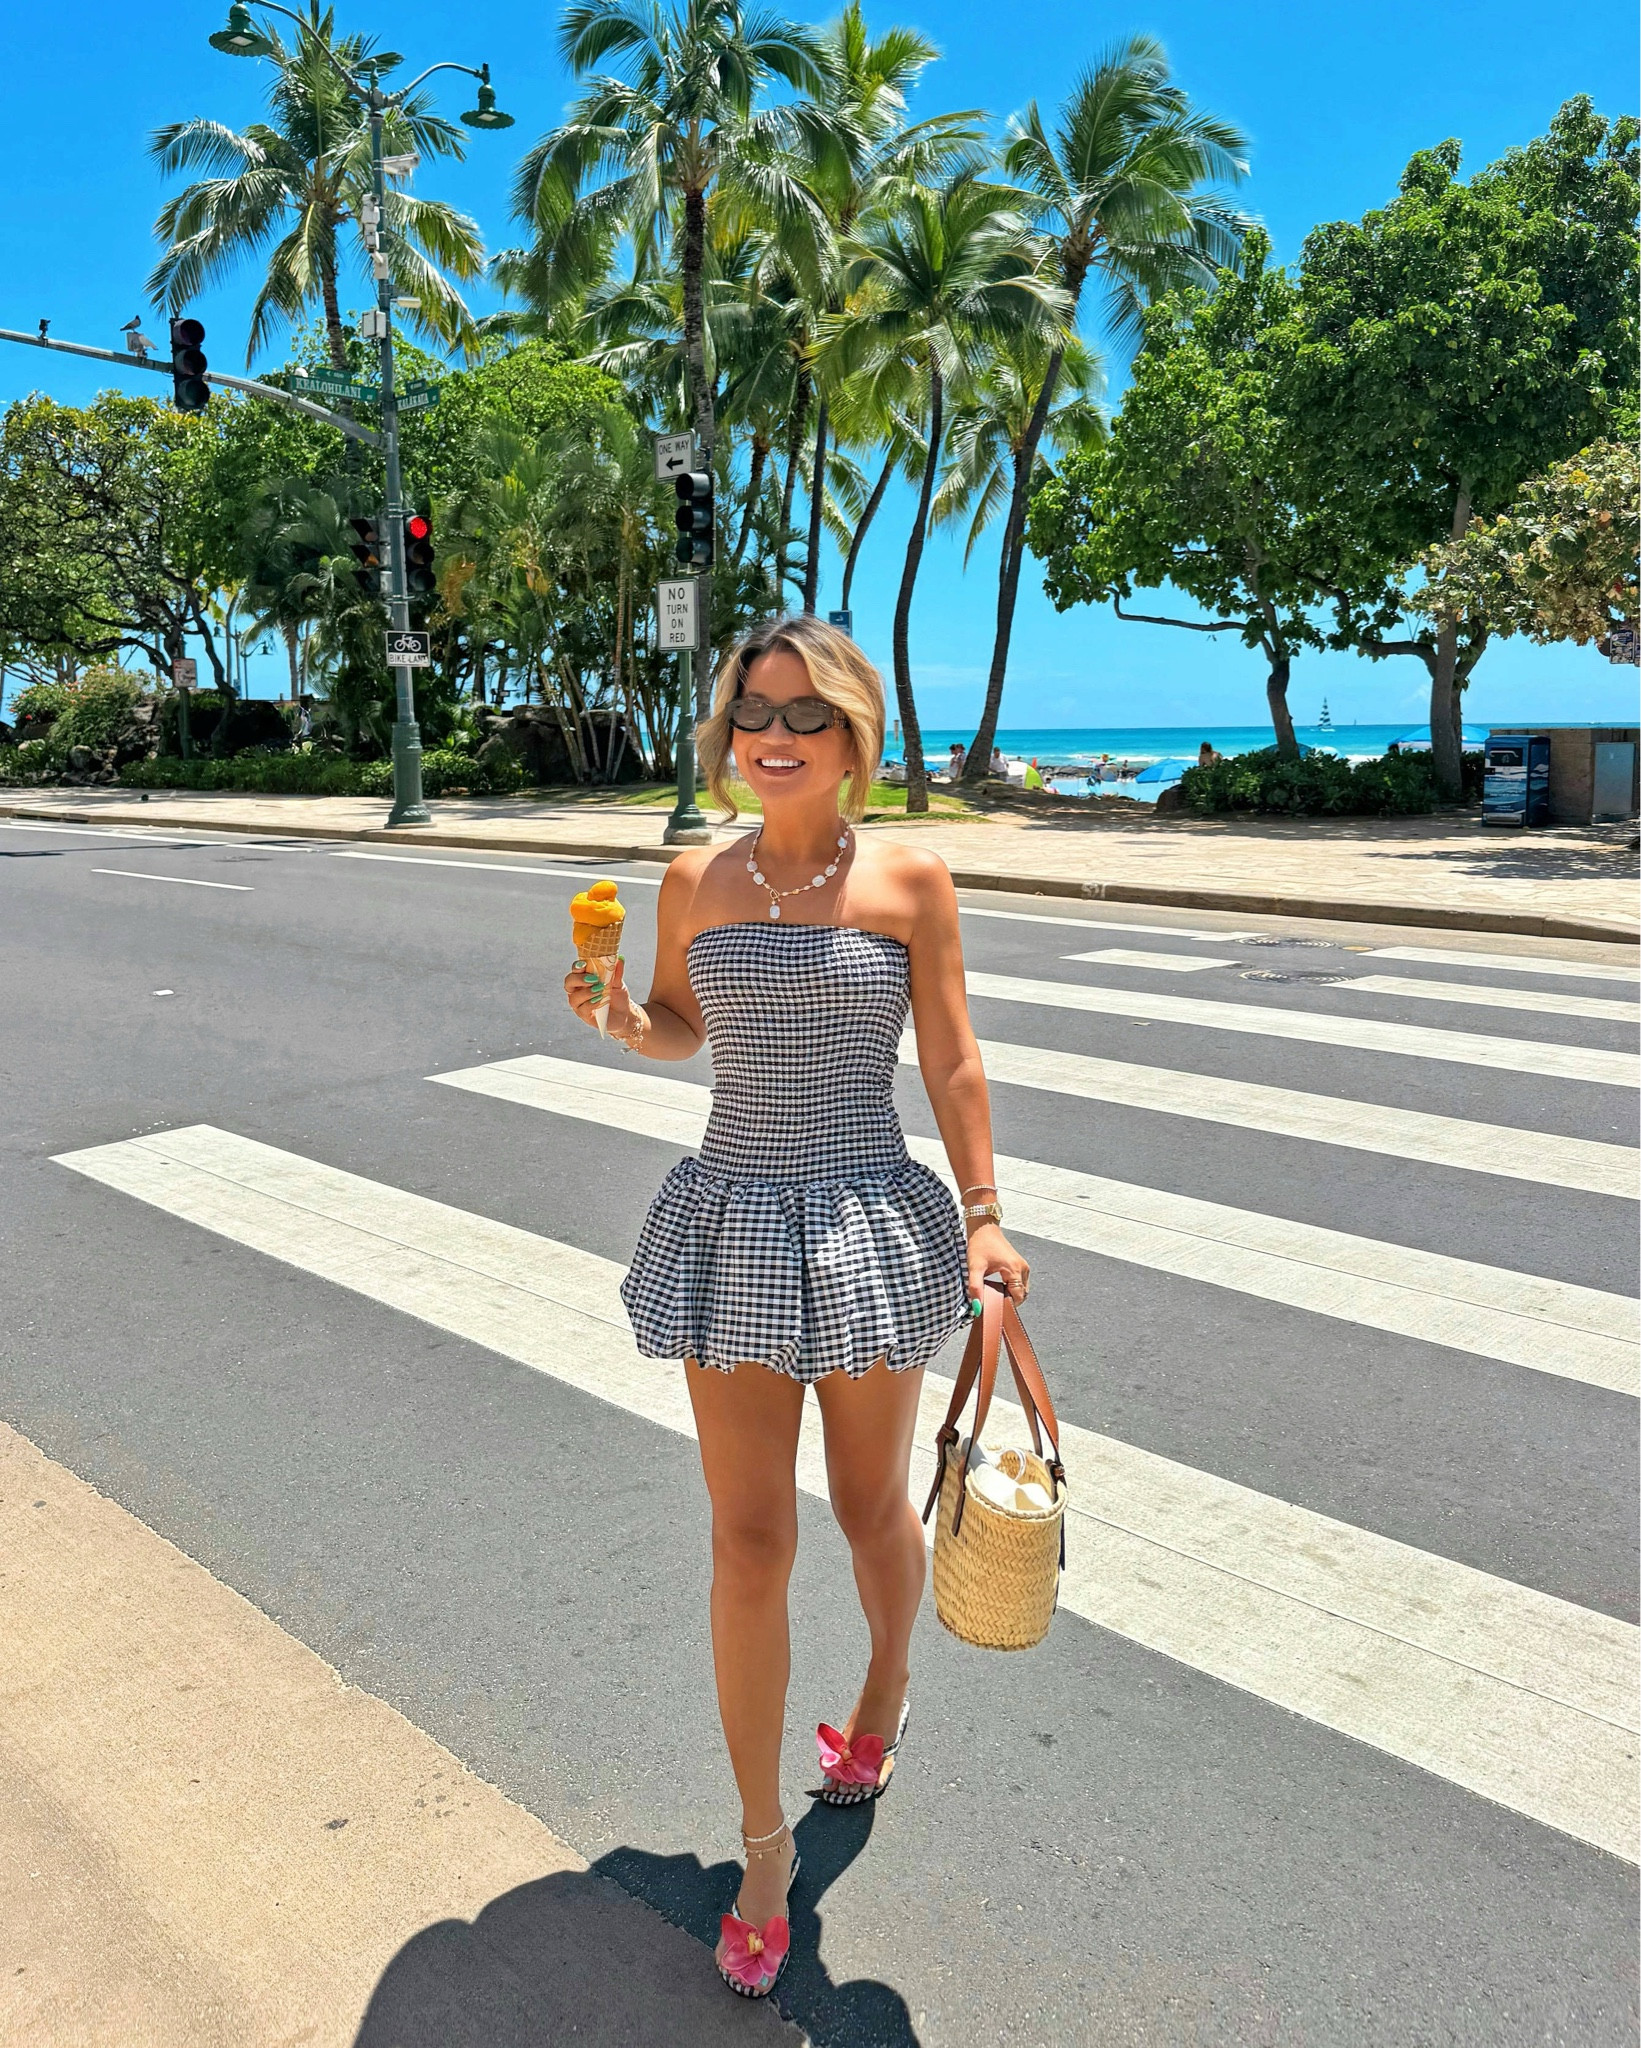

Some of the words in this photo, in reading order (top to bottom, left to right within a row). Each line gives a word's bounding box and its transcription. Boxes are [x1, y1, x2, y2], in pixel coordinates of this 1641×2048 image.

[296, 378, 361, 398] KEALOHILANI
[659, 443, 672, 455] ONE
[675, 440, 689, 451] WAY
[668, 587, 685, 600] NO
[667, 604, 688, 615] TURN
[671, 618, 684, 629] ON
[670, 633, 686, 643] RED
[389, 654, 406, 663] BIKE
